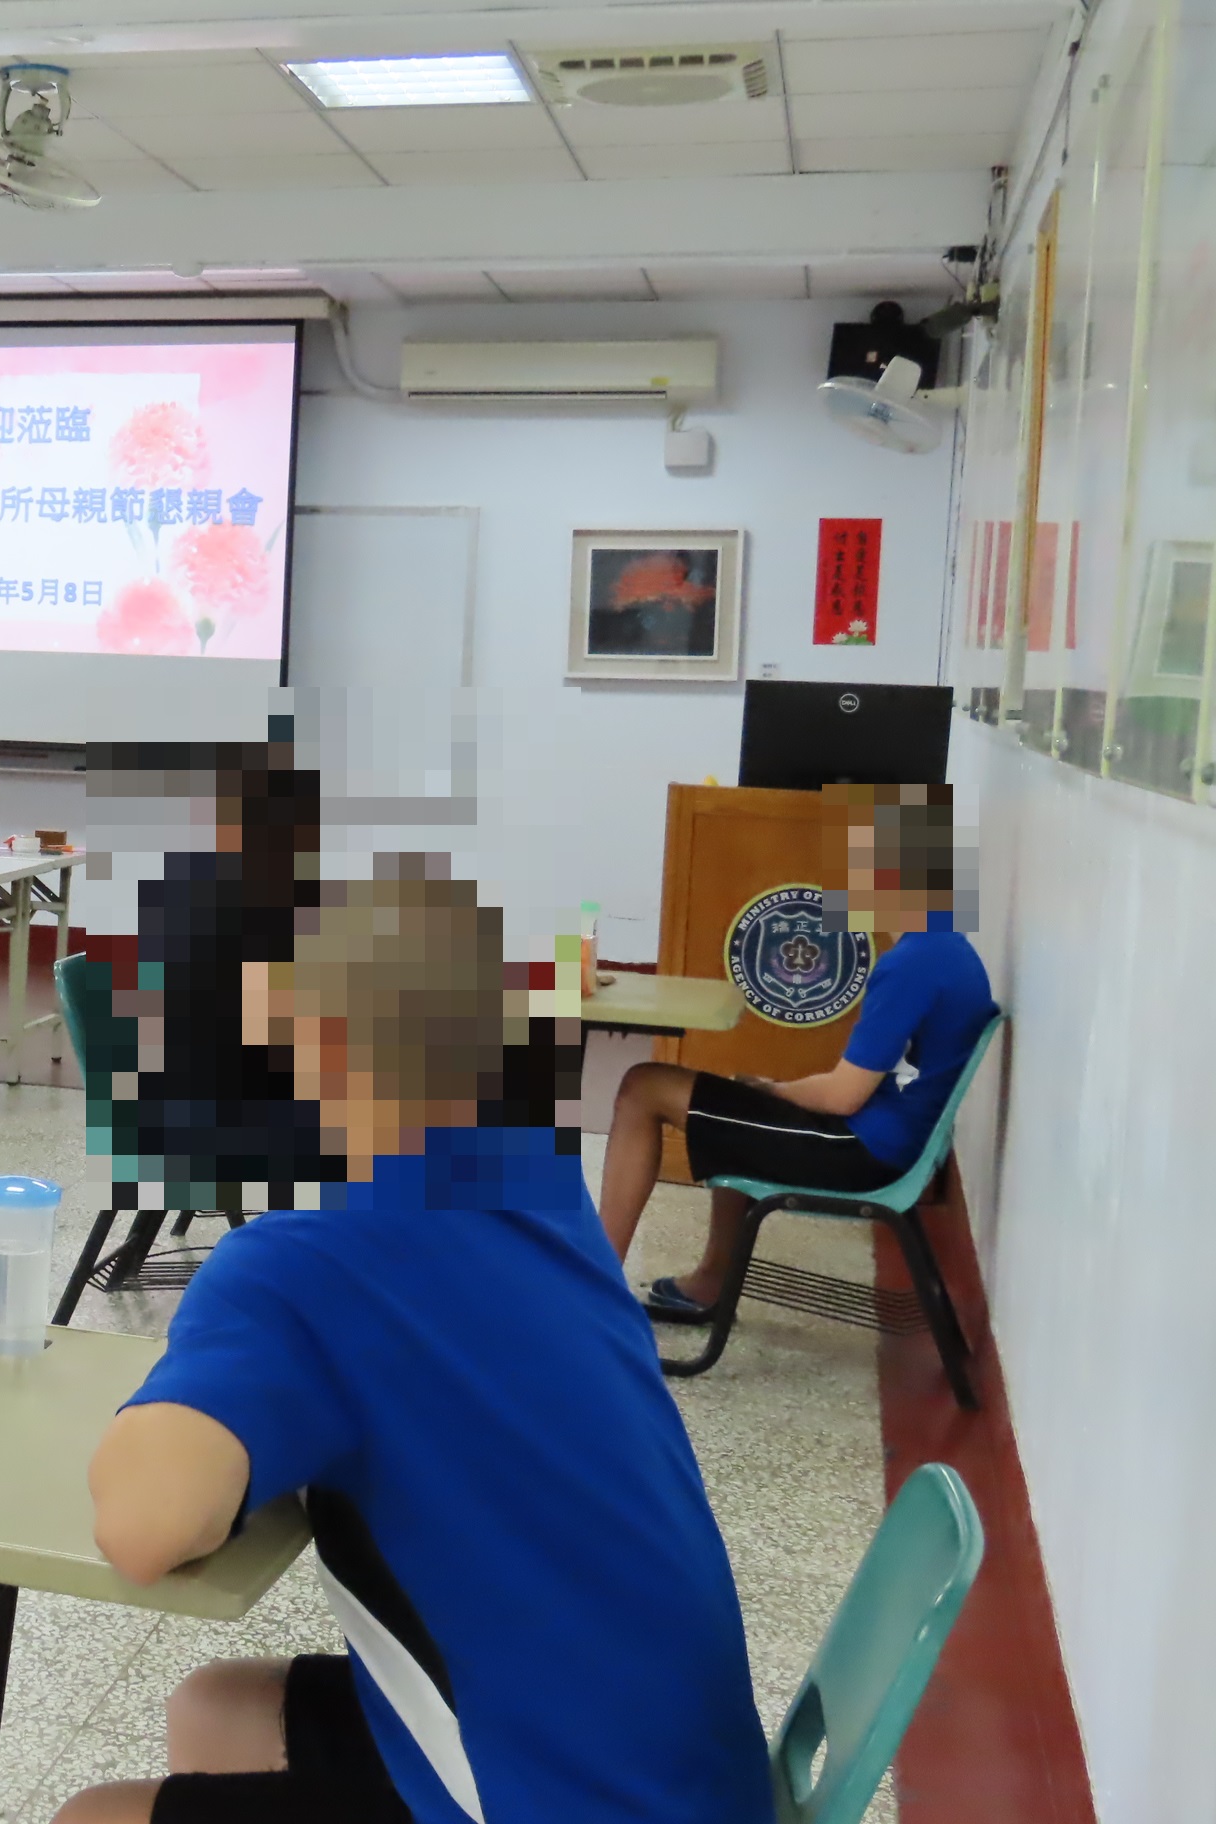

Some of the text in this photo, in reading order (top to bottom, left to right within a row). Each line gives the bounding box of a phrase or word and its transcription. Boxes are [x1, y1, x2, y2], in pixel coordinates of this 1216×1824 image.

[738, 890, 823, 931] MINISTRY OF
[731, 955, 867, 1022] AGENCY OF CORRECTIONS
